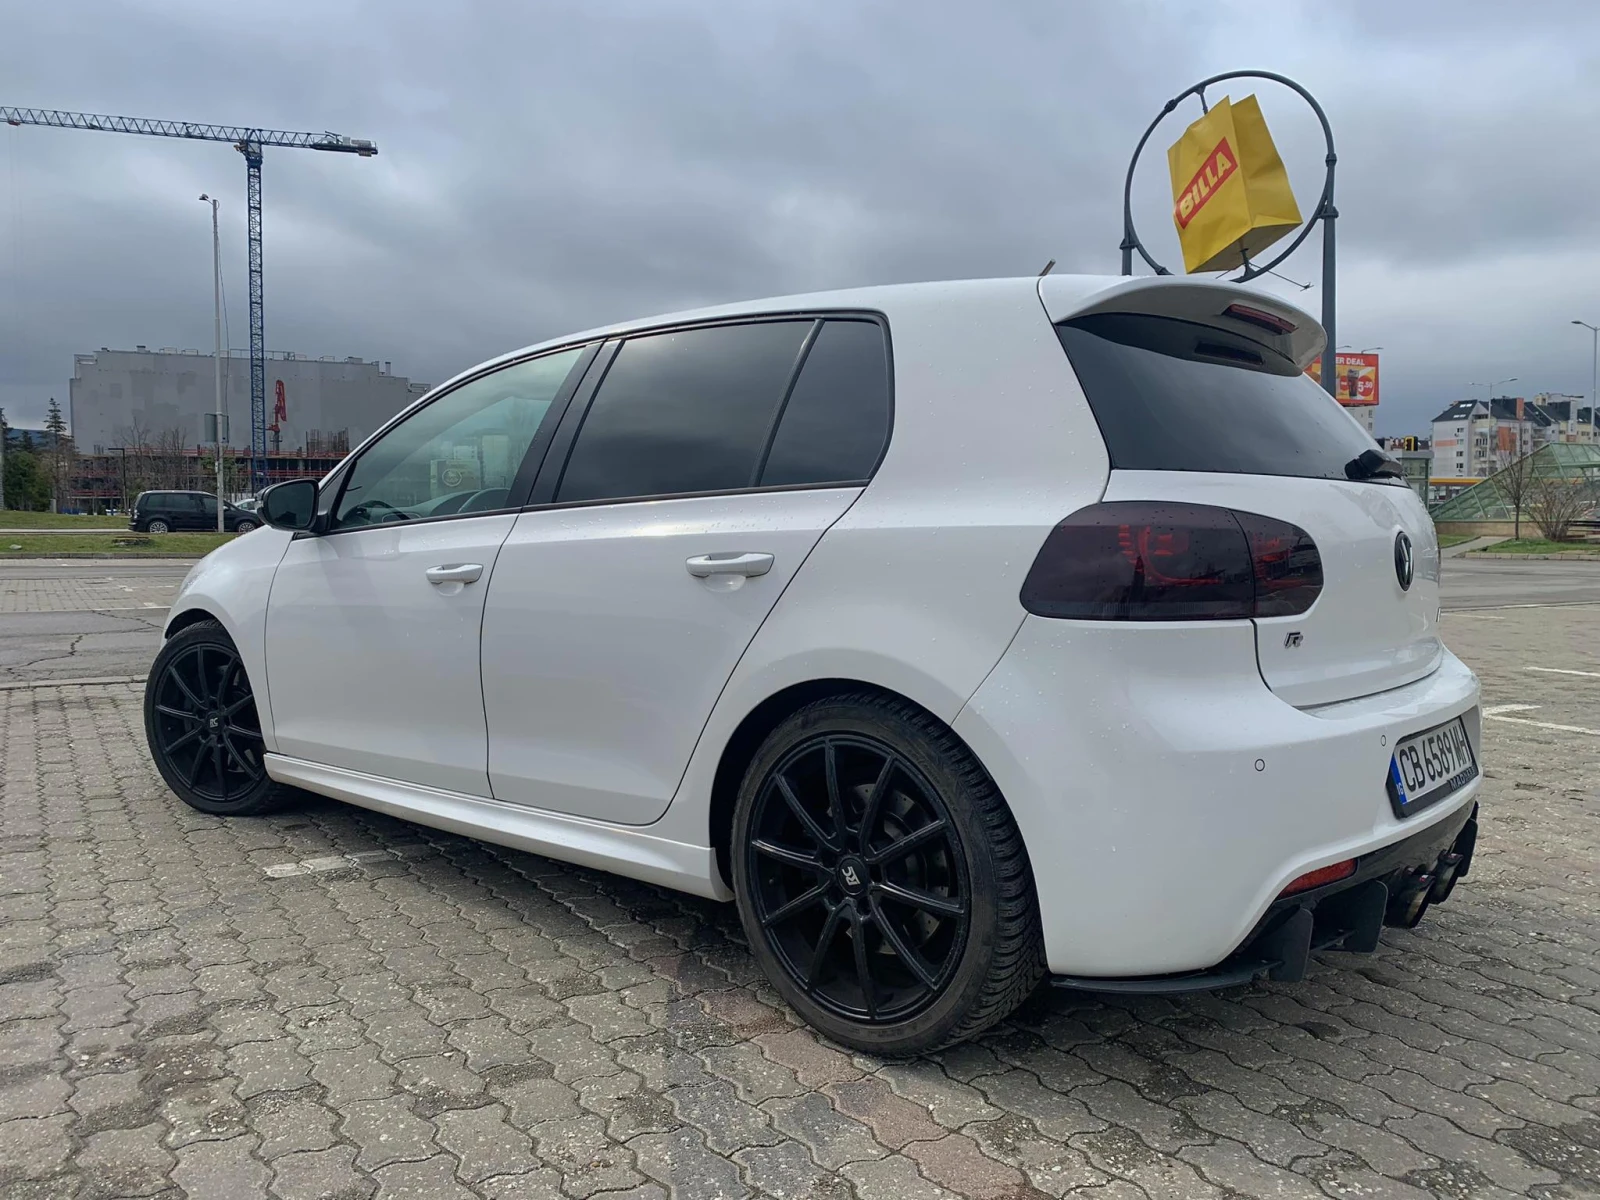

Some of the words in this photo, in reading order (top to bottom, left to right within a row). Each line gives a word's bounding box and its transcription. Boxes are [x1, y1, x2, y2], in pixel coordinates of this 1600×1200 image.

[1179, 151, 1232, 219] BILLA
[1284, 632, 1303, 648] R
[1399, 745, 1425, 792] CB
[1422, 731, 1456, 782] 6589
[1449, 723, 1471, 768] MH
[841, 866, 860, 886] RC
